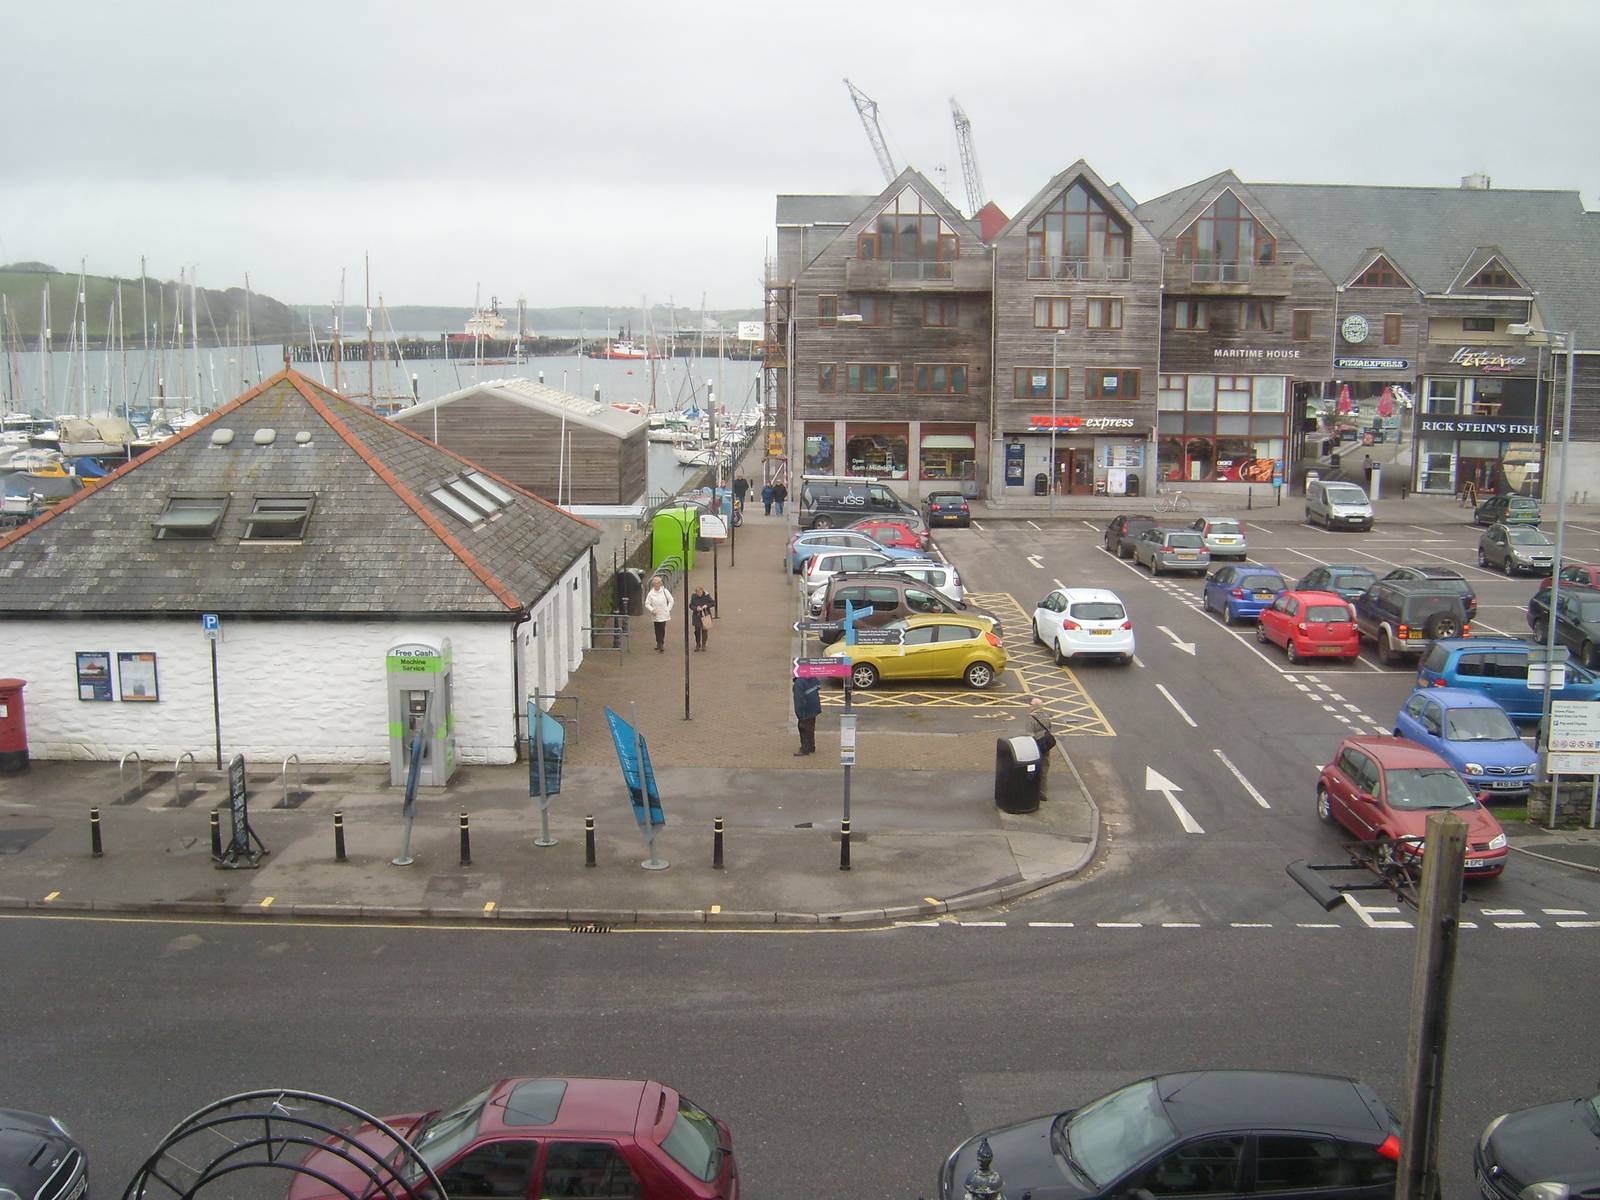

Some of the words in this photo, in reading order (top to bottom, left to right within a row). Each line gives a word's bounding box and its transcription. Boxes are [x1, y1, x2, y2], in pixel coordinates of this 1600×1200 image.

[1213, 349, 1264, 358] MARITIME
[1266, 350, 1301, 358] HOUSE
[1085, 417, 1135, 430] express
[1421, 421, 1455, 432] RICK
[1456, 422, 1506, 433] STEIN'S
[1509, 424, 1540, 434] FISH
[837, 495, 865, 506] JGS
[207, 616, 217, 628] P
